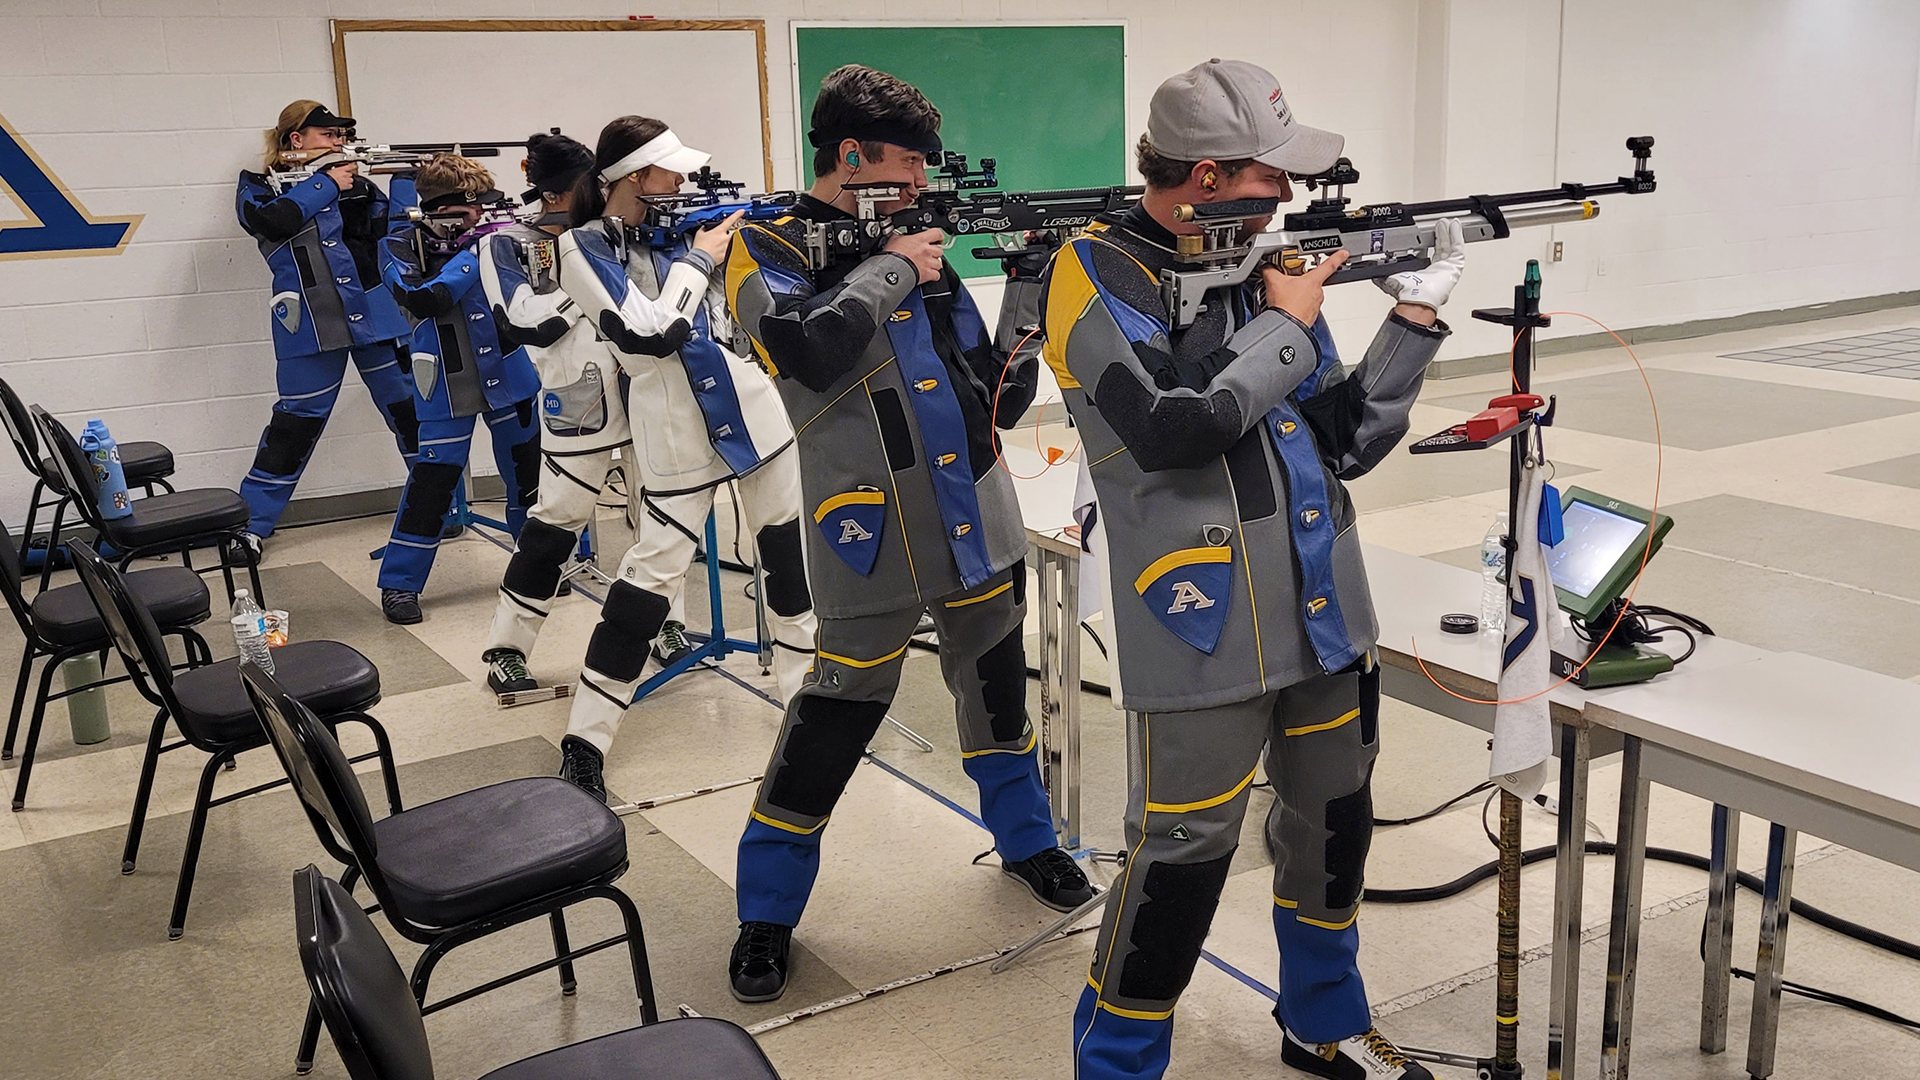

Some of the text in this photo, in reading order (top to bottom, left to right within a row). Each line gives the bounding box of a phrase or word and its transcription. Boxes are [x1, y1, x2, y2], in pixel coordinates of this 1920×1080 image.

[1373, 207, 1391, 217] 8002
[977, 219, 1006, 228] WALTHER
[1042, 217, 1086, 227] LG500
[546, 400, 559, 408] MD
[838, 519, 873, 544] A
[1167, 581, 1215, 614] A
